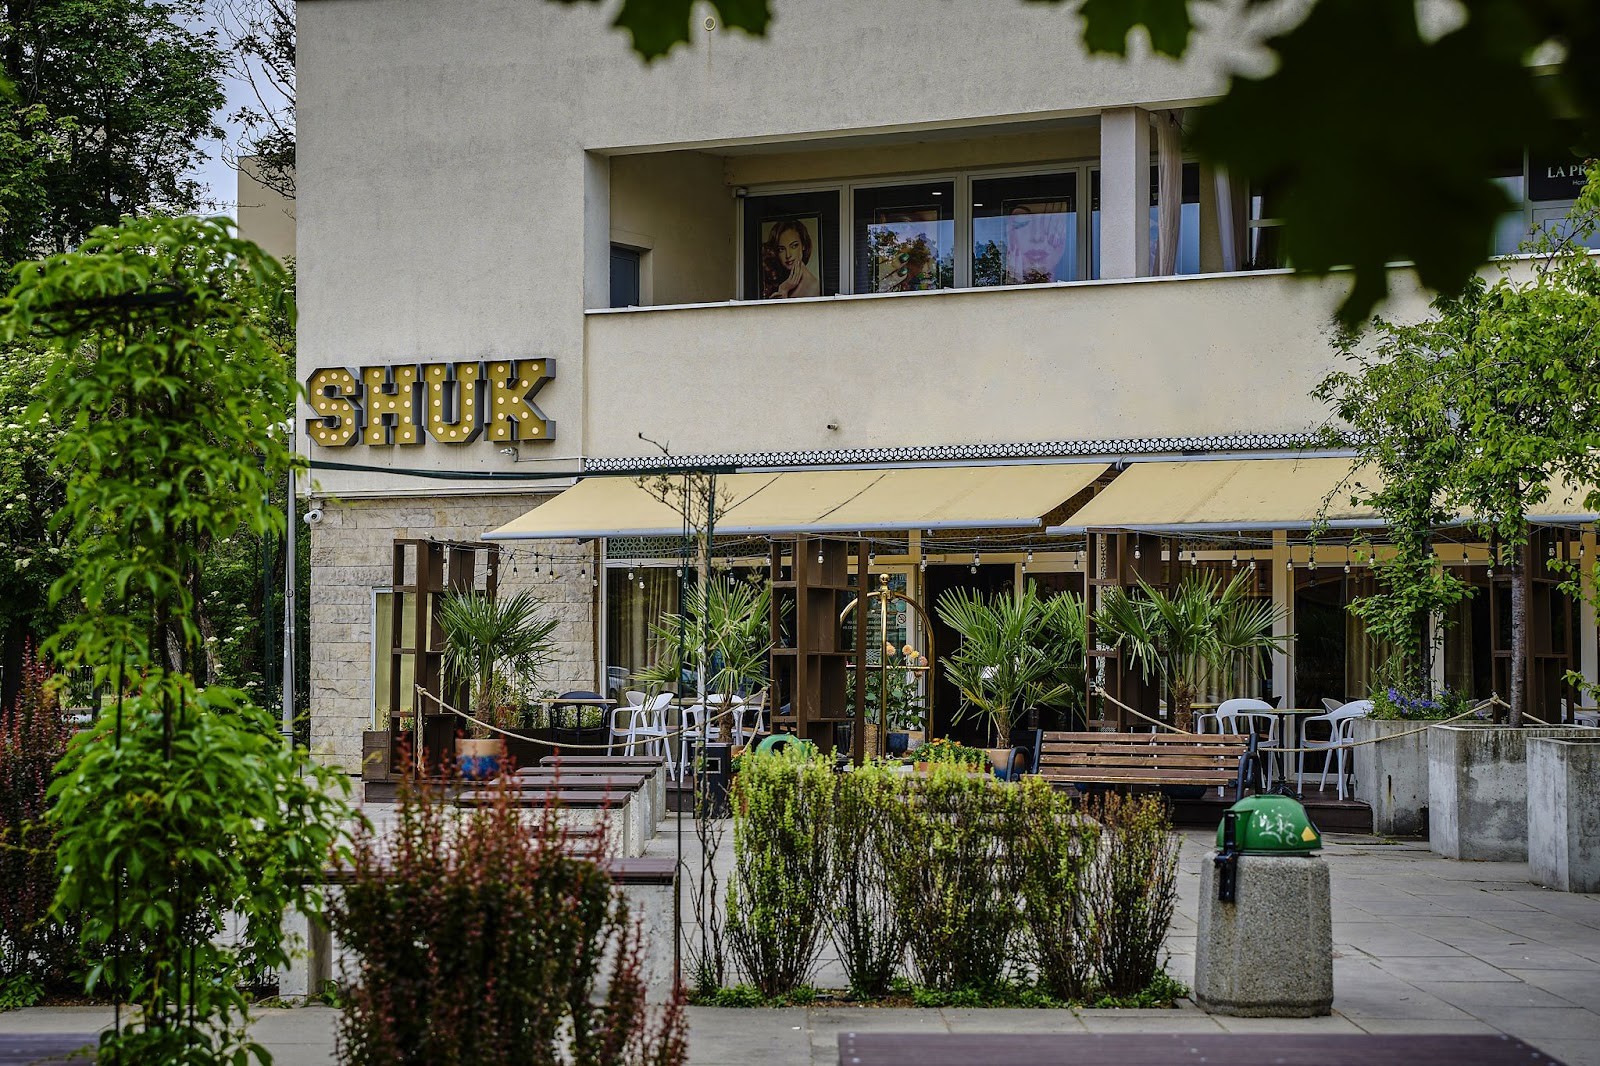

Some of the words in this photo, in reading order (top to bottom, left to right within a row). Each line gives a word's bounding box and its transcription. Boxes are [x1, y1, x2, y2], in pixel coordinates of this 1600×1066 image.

[1547, 166, 1566, 178] LA
[1569, 164, 1588, 176] PR
[305, 358, 556, 446] SHUK
